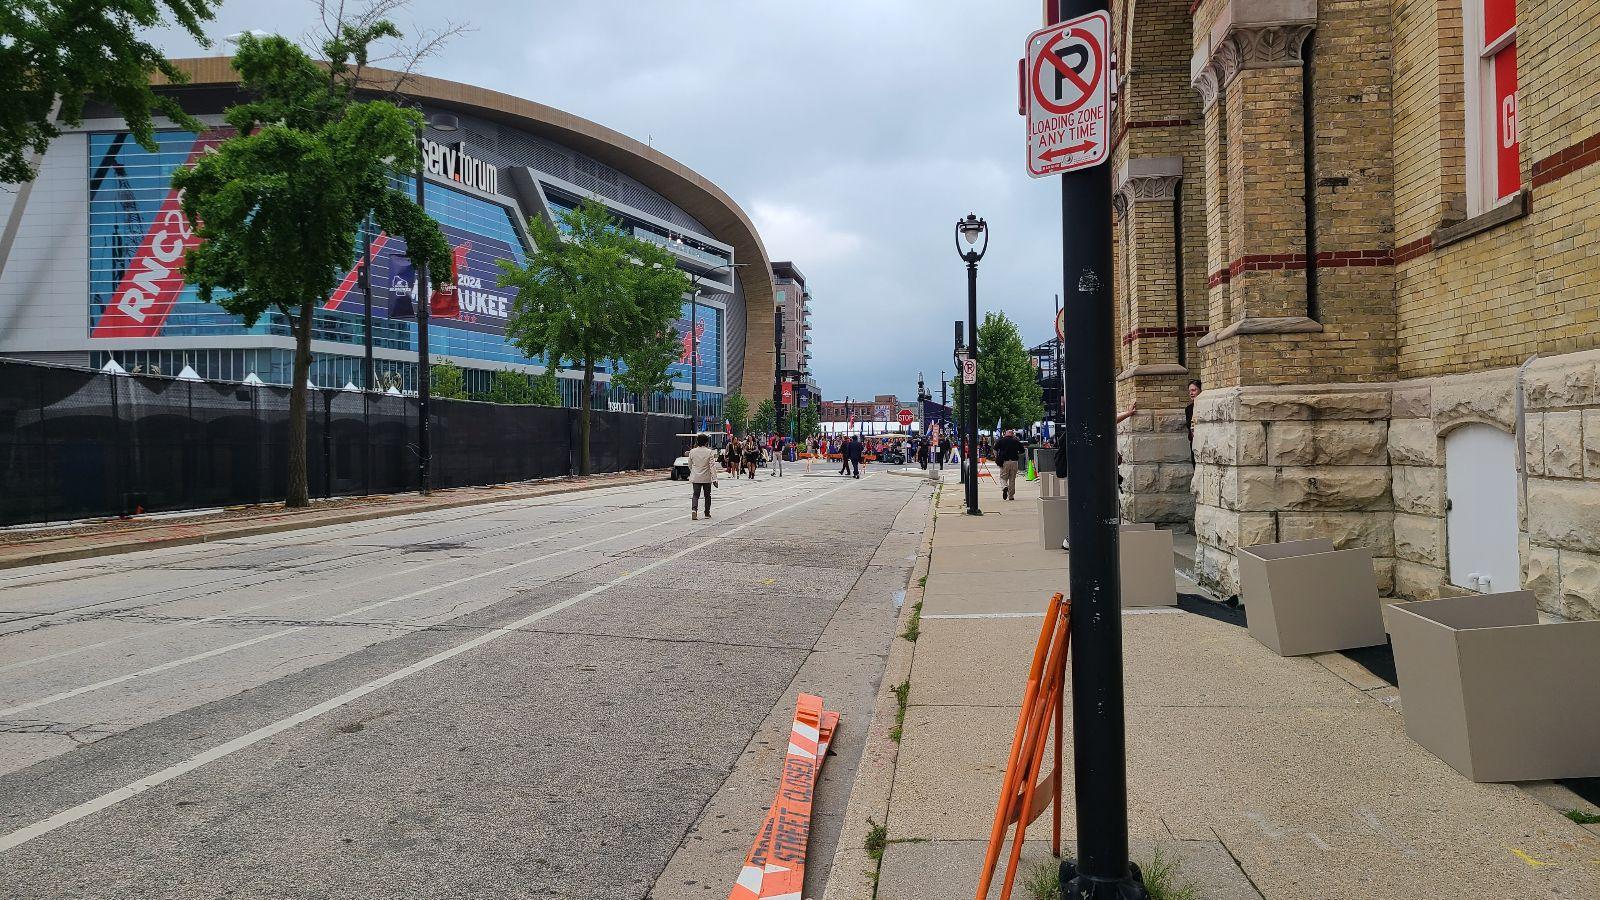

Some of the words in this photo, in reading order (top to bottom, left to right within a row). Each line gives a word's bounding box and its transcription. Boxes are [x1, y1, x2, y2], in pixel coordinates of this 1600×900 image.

[1032, 113, 1075, 135] LOADING
[1077, 105, 1104, 123] ZONE
[1038, 130, 1065, 149] ANY
[1069, 124, 1097, 141] TIME
[412, 137, 498, 195] serv.forum
[457, 273, 482, 289] 2024
[898, 414, 913, 422] STOP
[783, 758, 814, 803] CLOSED
[774, 807, 811, 864] STREET
